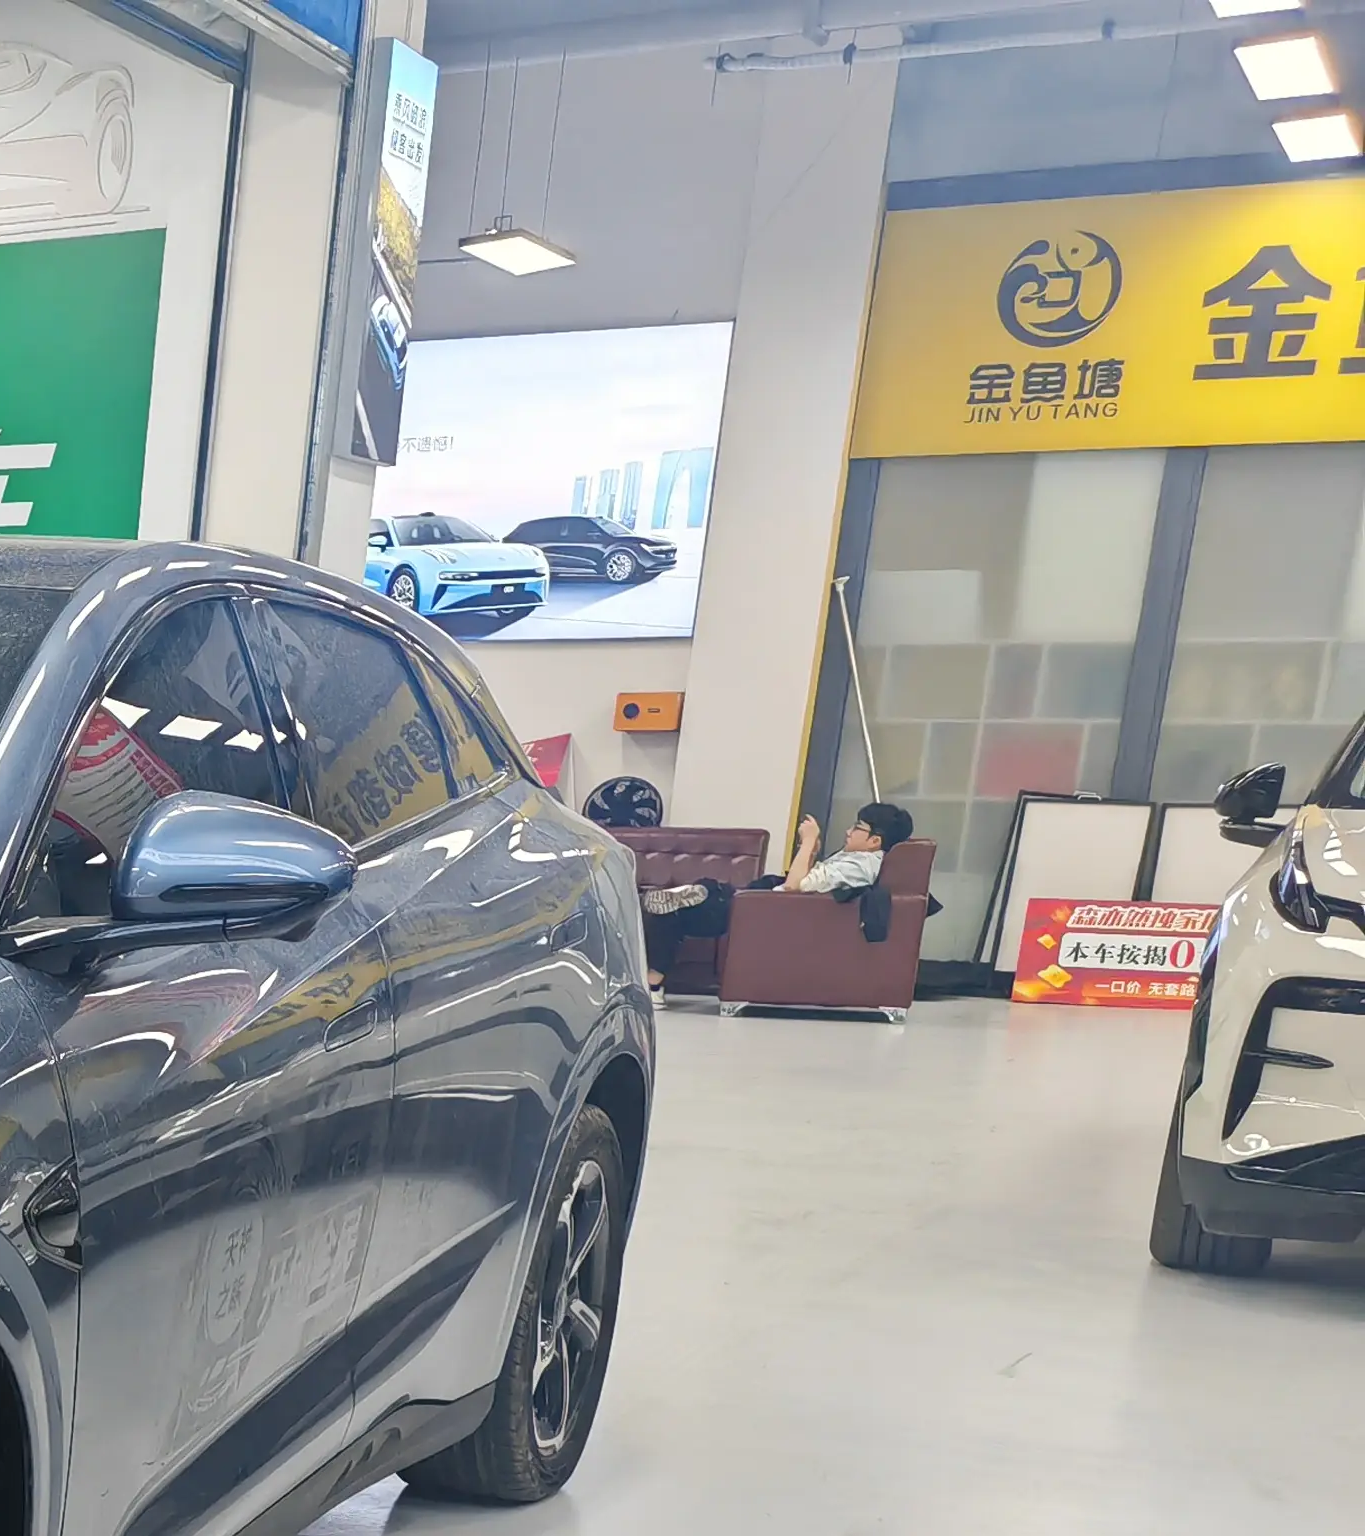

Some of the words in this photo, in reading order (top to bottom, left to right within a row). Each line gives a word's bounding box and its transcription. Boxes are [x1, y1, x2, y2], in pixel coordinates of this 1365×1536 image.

[1192, 245, 1365, 380] 金
[966, 358, 1125, 404] 金鱼塘
[964, 407, 1001, 423] JIN
[1009, 404, 1042, 421] YU
[1050, 402, 1118, 420] TANG
[398, 436, 454, 454] 不遗憾!
[1095, 981, 1141, 995] 一口价
[1148, 982, 1196, 997] 无套路
